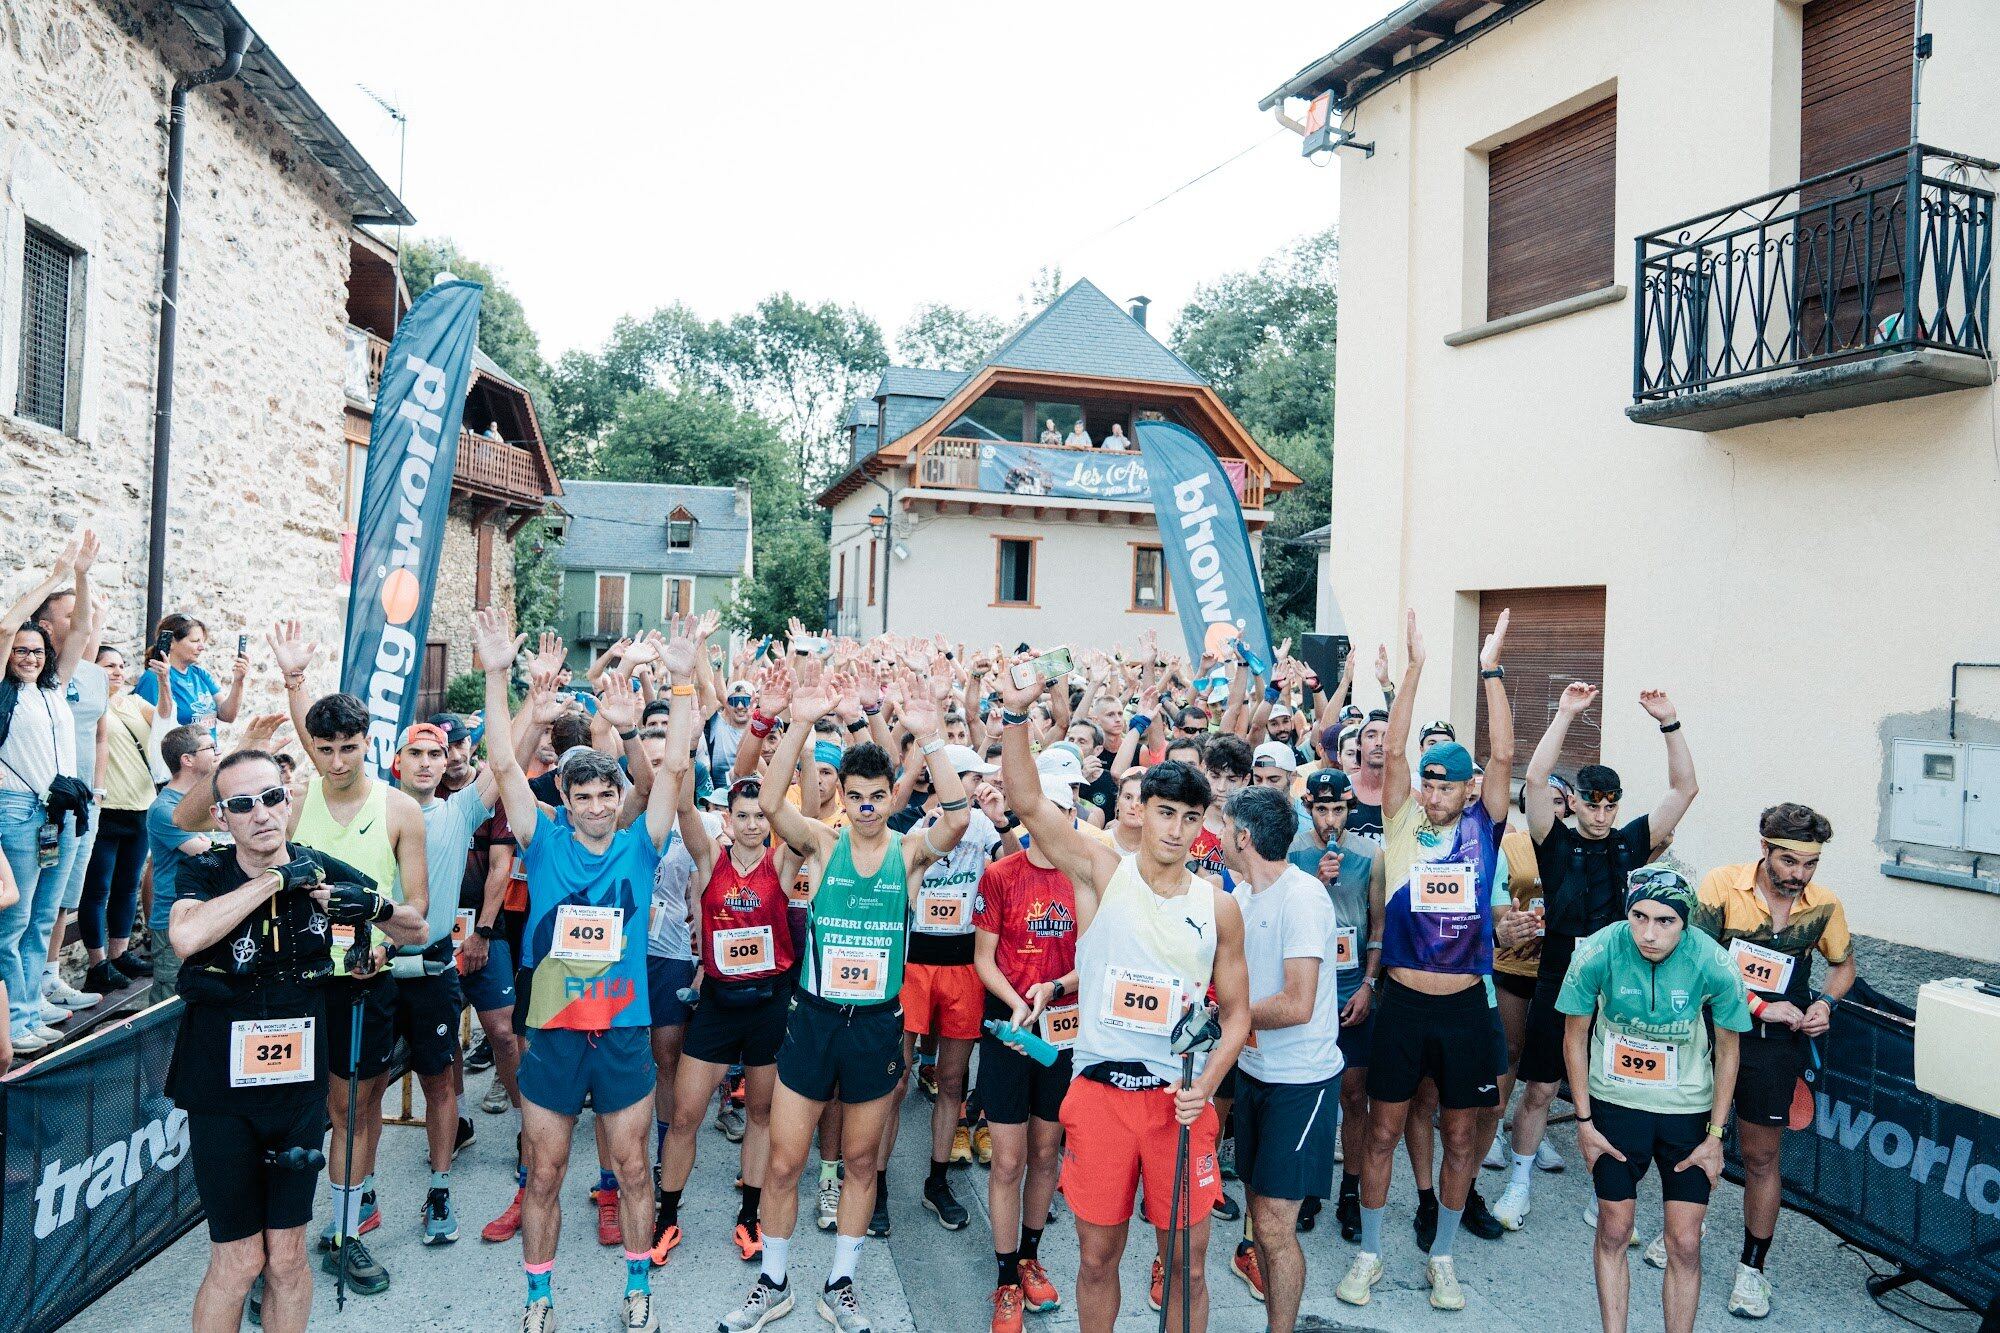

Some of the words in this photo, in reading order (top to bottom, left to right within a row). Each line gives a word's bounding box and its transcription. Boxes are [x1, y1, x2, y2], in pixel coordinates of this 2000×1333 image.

[392, 353, 446, 566] world
[1066, 462, 1102, 493] Les
[1426, 882, 1459, 894] 500
[930, 905, 957, 917] 307
[816, 916, 862, 929] GOIERRI
[1049, 920, 1072, 931] TRAIL
[569, 926, 605, 940] 403
[823, 932, 892, 947] ATLETISMO
[730, 944, 759, 958] 508
[840, 966, 869, 980] 391
[1745, 963, 1772, 980] 411
[1124, 992, 1159, 1011] 510
[1053, 1016, 1079, 1032] 502
[256, 1043, 293, 1061] 321
[1621, 1054, 1657, 1071] 399
